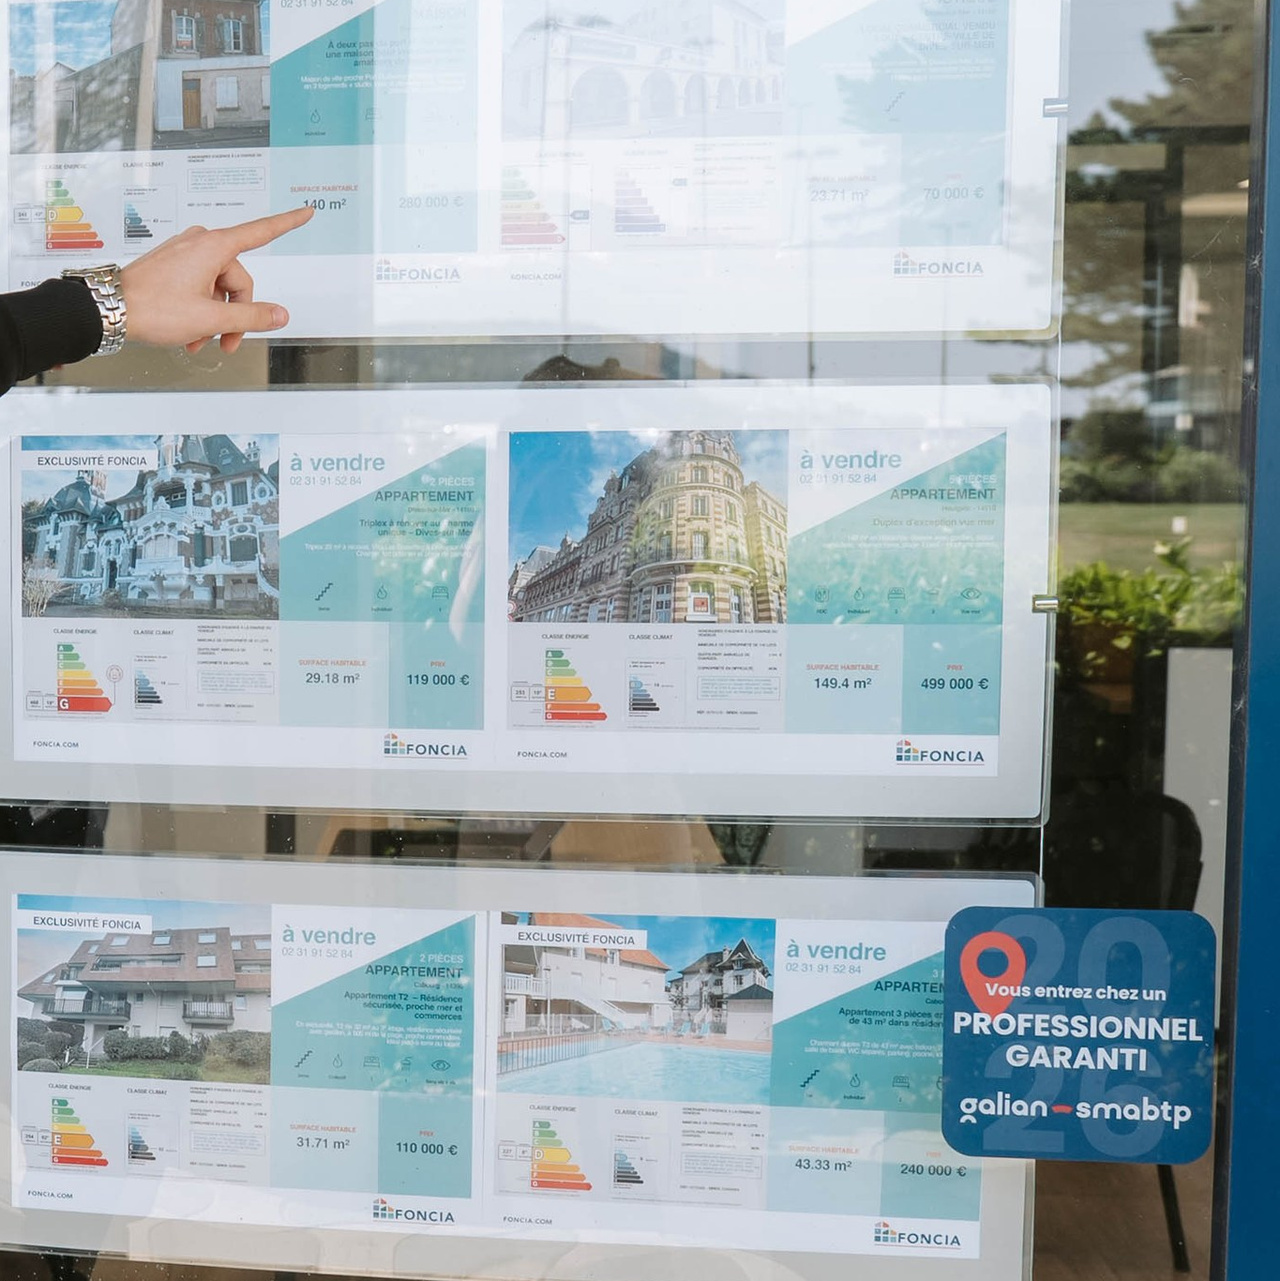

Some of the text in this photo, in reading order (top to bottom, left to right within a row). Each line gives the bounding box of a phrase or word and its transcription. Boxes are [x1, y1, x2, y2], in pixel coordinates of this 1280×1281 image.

[923, 187, 984, 200] 70 000 €
[303, 198, 347, 210] 140 m²
[399, 196, 420, 209] 280
[425, 196, 449, 208] 000
[918, 262, 984, 274] FONCIA
[399, 269, 460, 280] FONCIA
[38, 455, 147, 466] EXCLUSIVITÉ FONCIA
[290, 453, 385, 471] à vendre
[801, 450, 902, 469] à vendre
[290, 477, 362, 485] 02 31 91 52 84
[375, 491, 474, 502] APPARTEMENT
[890, 488, 996, 500] APPARTEMENT
[360, 520, 386, 528] Triplex
[306, 673, 360, 684] 29.18 m²
[407, 674, 469, 686] 119 000 €
[815, 678, 872, 689] 149.4 m²
[921, 678, 989, 690] 499 000 €
[406, 744, 467, 756] FONCIA
[920, 751, 984, 762] FONCIA
[33, 916, 141, 930] EXCLUSIVITÉ FONCIA
[282, 924, 376, 945] à vendre
[518, 931, 635, 946] EXCLUSIVITÉ FONCIA
[282, 947, 353, 958] 02 31 91 52 84
[787, 939, 886, 961] à vendre
[420, 953, 463, 964] 2 PIÈCES
[365, 965, 463, 978] APPARTEMENT
[786, 963, 861, 974] 02 31 91 52 84
[344, 991, 462, 1003] Appartement T2 Résidence
[985, 983, 1166, 1001] Vous entrez chez un
[406, 1003, 435, 1012] proche
[839, 1007, 894, 1019] Appartement
[904, 1010, 932, 1020] pièces
[849, 1017, 860, 1025] de
[862, 1017, 872, 1025] 43
[889, 1018, 909, 1026] dans
[954, 1012, 1203, 1041] PROFESSIONNEL
[1006, 1045, 1147, 1071] GARANTI
[960, 1092, 1192, 1129] galian smabtp
[296, 1137, 350, 1150] 31.71 m²
[396, 1142, 457, 1156] 110 000 €
[795, 1159, 852, 1171] 43.33 m²
[900, 1164, 966, 1177] 240 000 €
[28, 1190, 73, 1199] FONCIA.COM
[395, 1209, 455, 1222] FONCIA
[502, 1216, 552, 1225] FONCIA.COM
[898, 1233, 961, 1246] FONCIA
